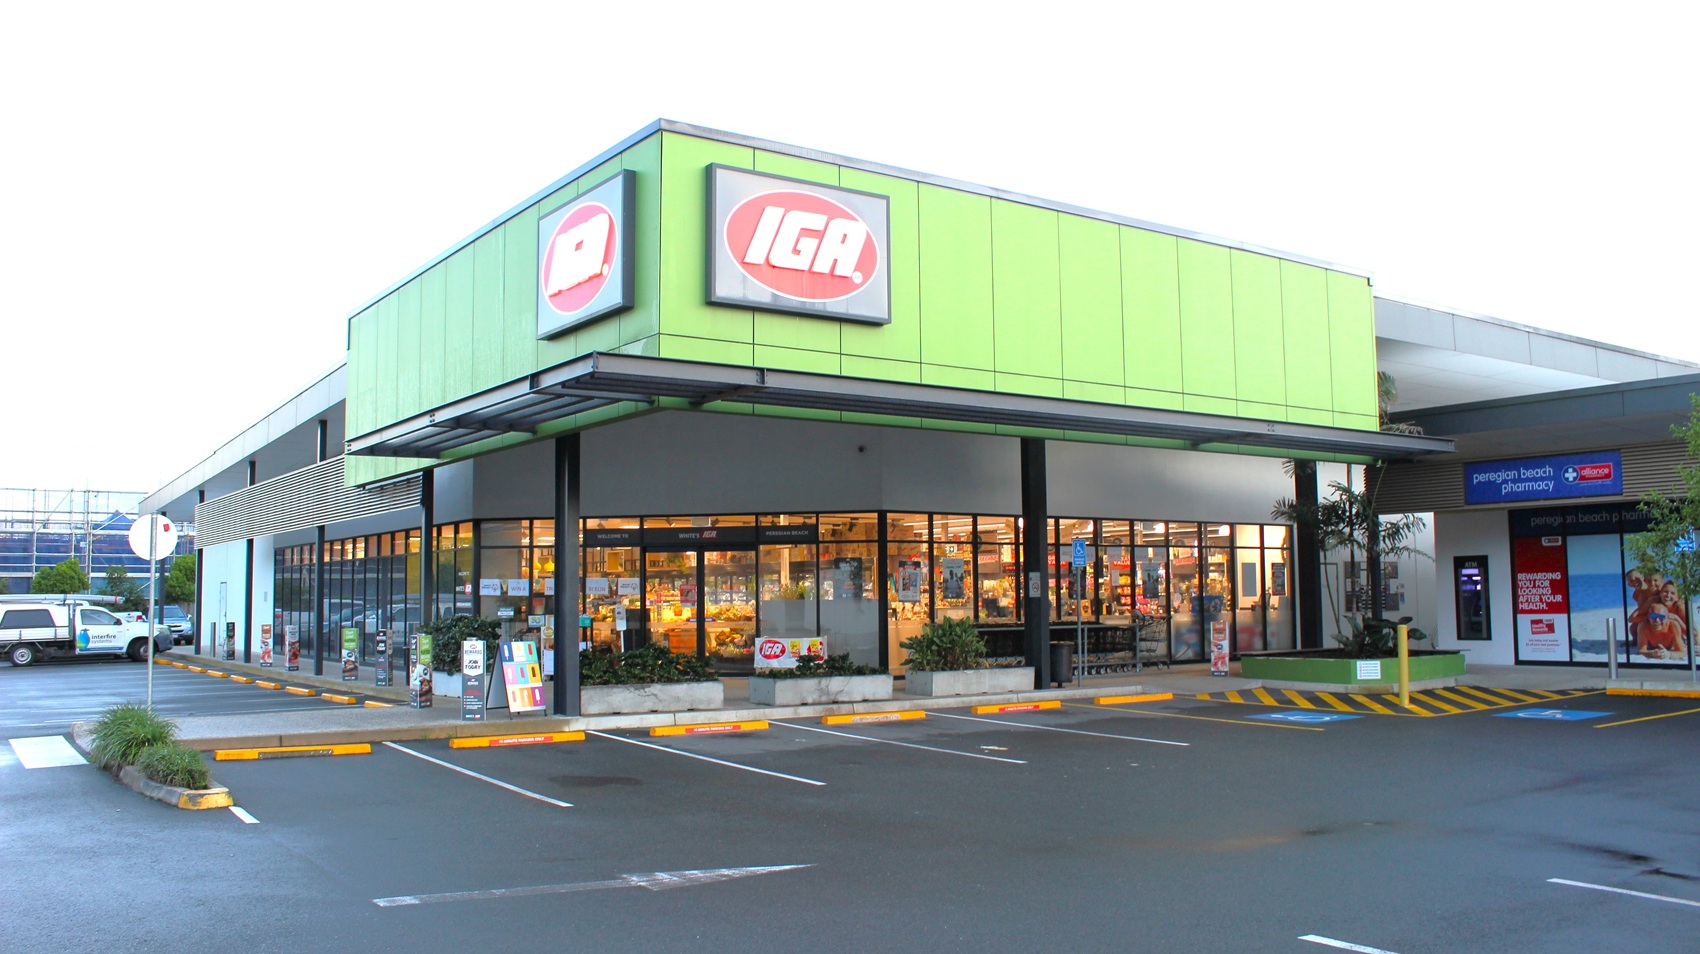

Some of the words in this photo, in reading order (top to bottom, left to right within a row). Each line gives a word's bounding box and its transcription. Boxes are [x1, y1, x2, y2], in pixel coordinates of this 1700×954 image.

[1473, 469, 1518, 485] peregian
[1520, 464, 1553, 478] beach
[1581, 467, 1609, 476] alliance
[1502, 480, 1554, 495] pharmacy
[1579, 511, 1610, 523] beach
[702, 530, 718, 538] IGA
[1517, 572, 1561, 580] REWARDING
[1518, 587, 1551, 595] LOOKING
[1541, 594, 1562, 602] YOUR
[1519, 602, 1549, 610] HEALTH.
[761, 643, 783, 655] IGA
